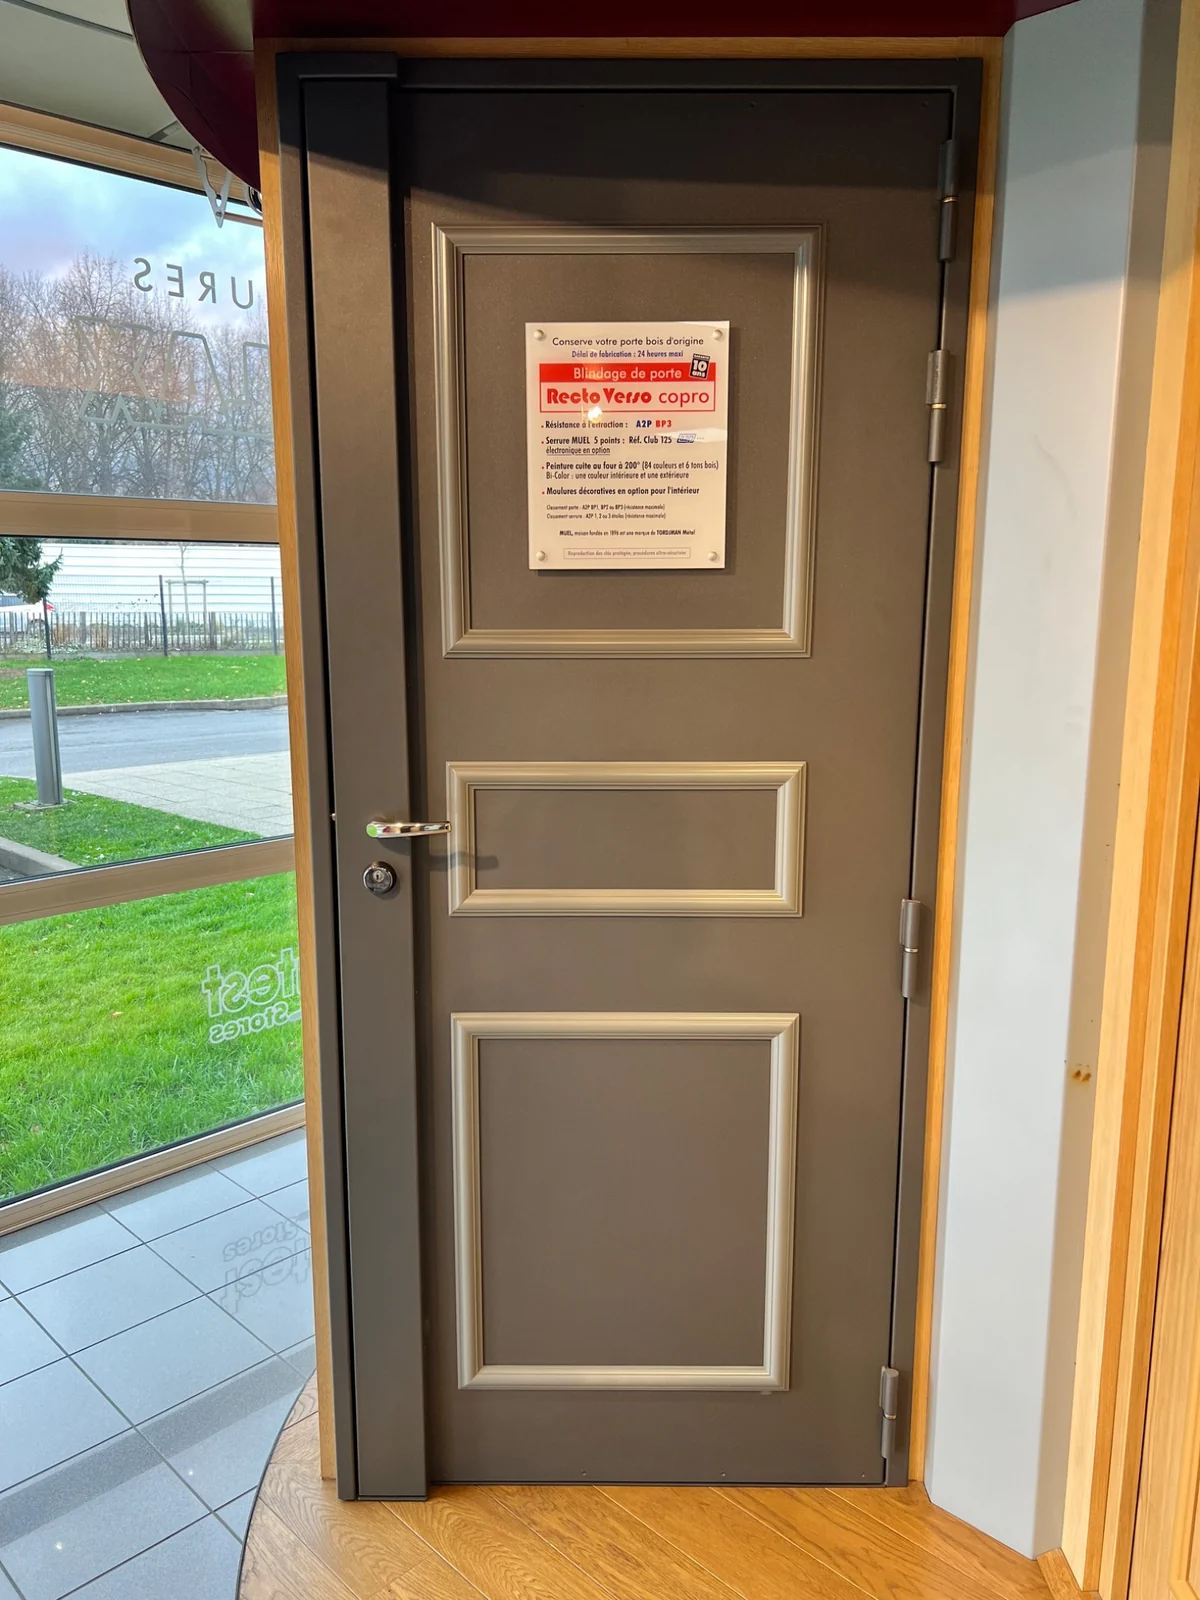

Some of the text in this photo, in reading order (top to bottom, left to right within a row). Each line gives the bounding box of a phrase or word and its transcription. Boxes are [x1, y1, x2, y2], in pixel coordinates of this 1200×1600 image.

[552, 336, 704, 349] Conserve votre porte bois d'origine
[571, 350, 588, 358] Délai
[599, 350, 632, 358] fabrication
[637, 350, 645, 358] 24
[693, 358, 708, 372] 10
[573, 367, 682, 382] Blindage de porte
[691, 370, 706, 378] ans
[547, 388, 709, 408] Recto Verso copro
[545, 420, 580, 429] Résistance
[636, 420, 652, 428] A2P
[655, 419, 672, 428] BP3
[546, 437, 570, 445] Serrure
[600, 436, 621, 447] points
[628, 435, 642, 444] Réf.
[644, 435, 659, 444] Club
[661, 435, 672, 444] 125
[546, 446, 581, 455] électronique
[592, 447, 610, 455] option
[546, 462, 574, 470] Peinture
[575, 462, 592, 470] cuite
[603, 461, 617, 470] four
[618, 461, 623, 469] à
[624, 461, 641, 470] 200°
[641, 461, 652, 471] (84
[653, 461, 677, 470] couleurs
[685, 461, 690, 469] 6
[704, 461, 719, 470] bois)
[546, 471, 570, 479] Bi-Color
[587, 471, 609, 479] couleur
[610, 471, 639, 479] intérieure
[660, 471, 689, 479] extérieure
[546, 487, 577, 495] Moulures
[578, 487, 616, 495] décoratives
[628, 487, 649, 497] option
[650, 489, 666, 497] pour
[667, 486, 700, 495] l'intérieur
